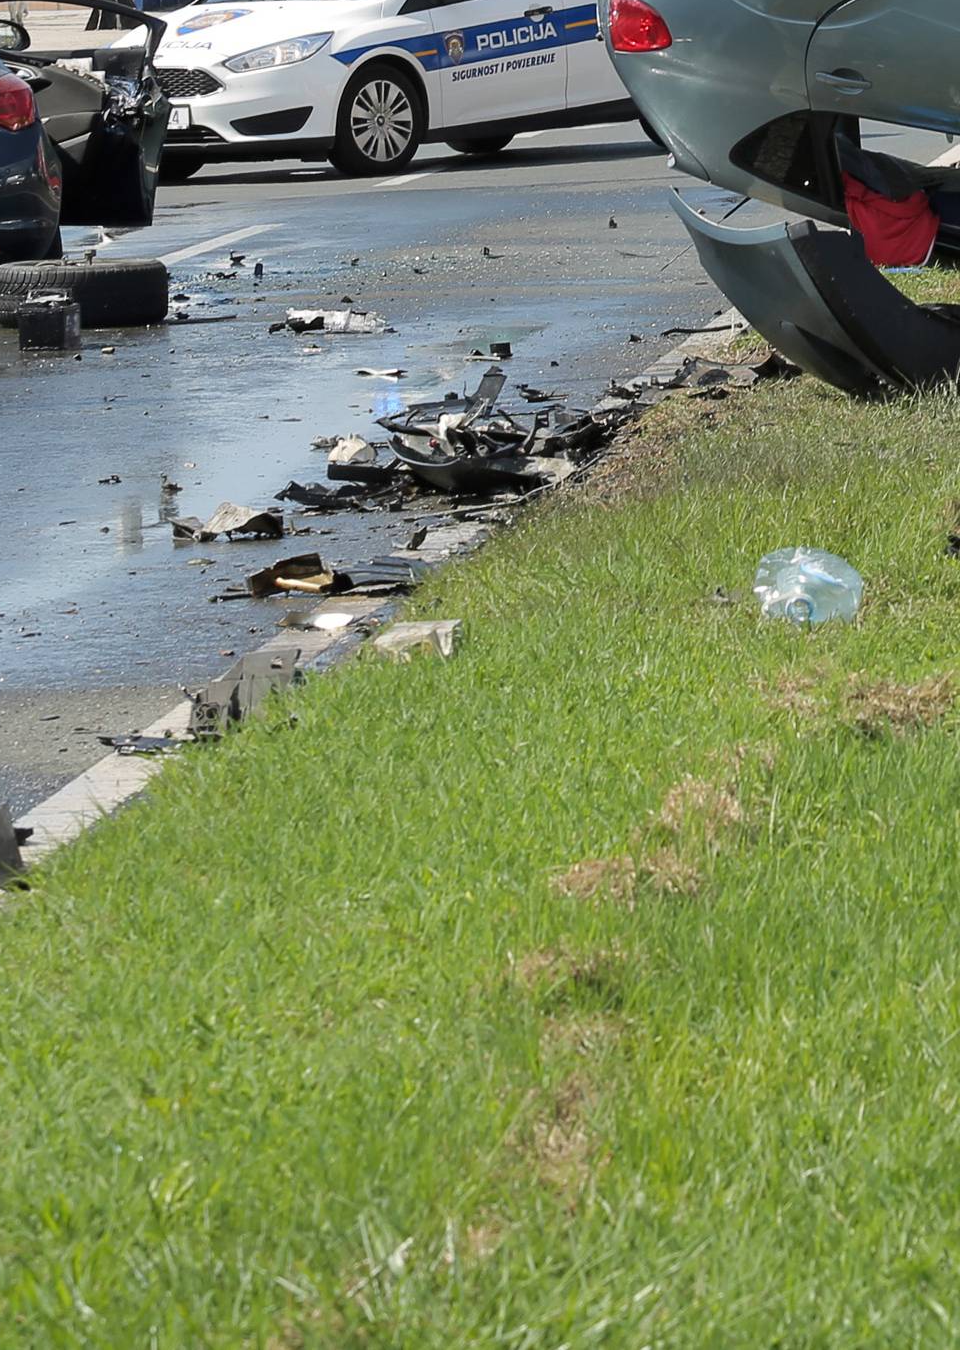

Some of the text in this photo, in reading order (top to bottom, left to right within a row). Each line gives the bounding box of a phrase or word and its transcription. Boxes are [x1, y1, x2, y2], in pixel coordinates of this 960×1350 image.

[162, 41, 212, 50] ICIJA
[476, 22, 558, 51] POLICIJA
[452, 53, 556, 82] SIGURNOST I POVJERENJE
